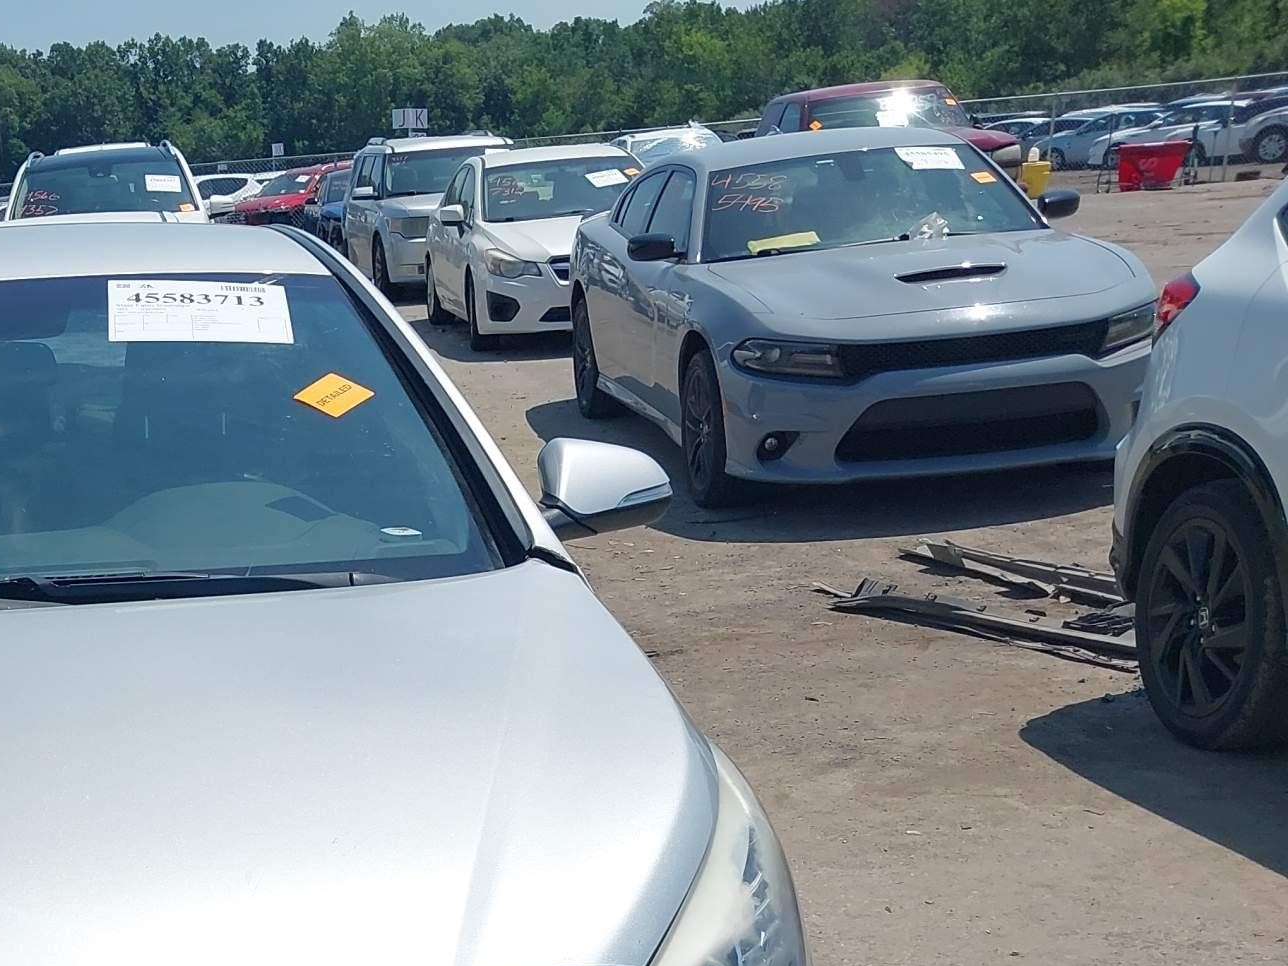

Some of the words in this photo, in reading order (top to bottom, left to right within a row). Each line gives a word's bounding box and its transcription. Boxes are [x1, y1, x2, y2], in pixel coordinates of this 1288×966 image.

[415, 110, 425, 127] K
[126, 292, 265, 307] 45583713
[315, 383, 353, 407] DETAILED
